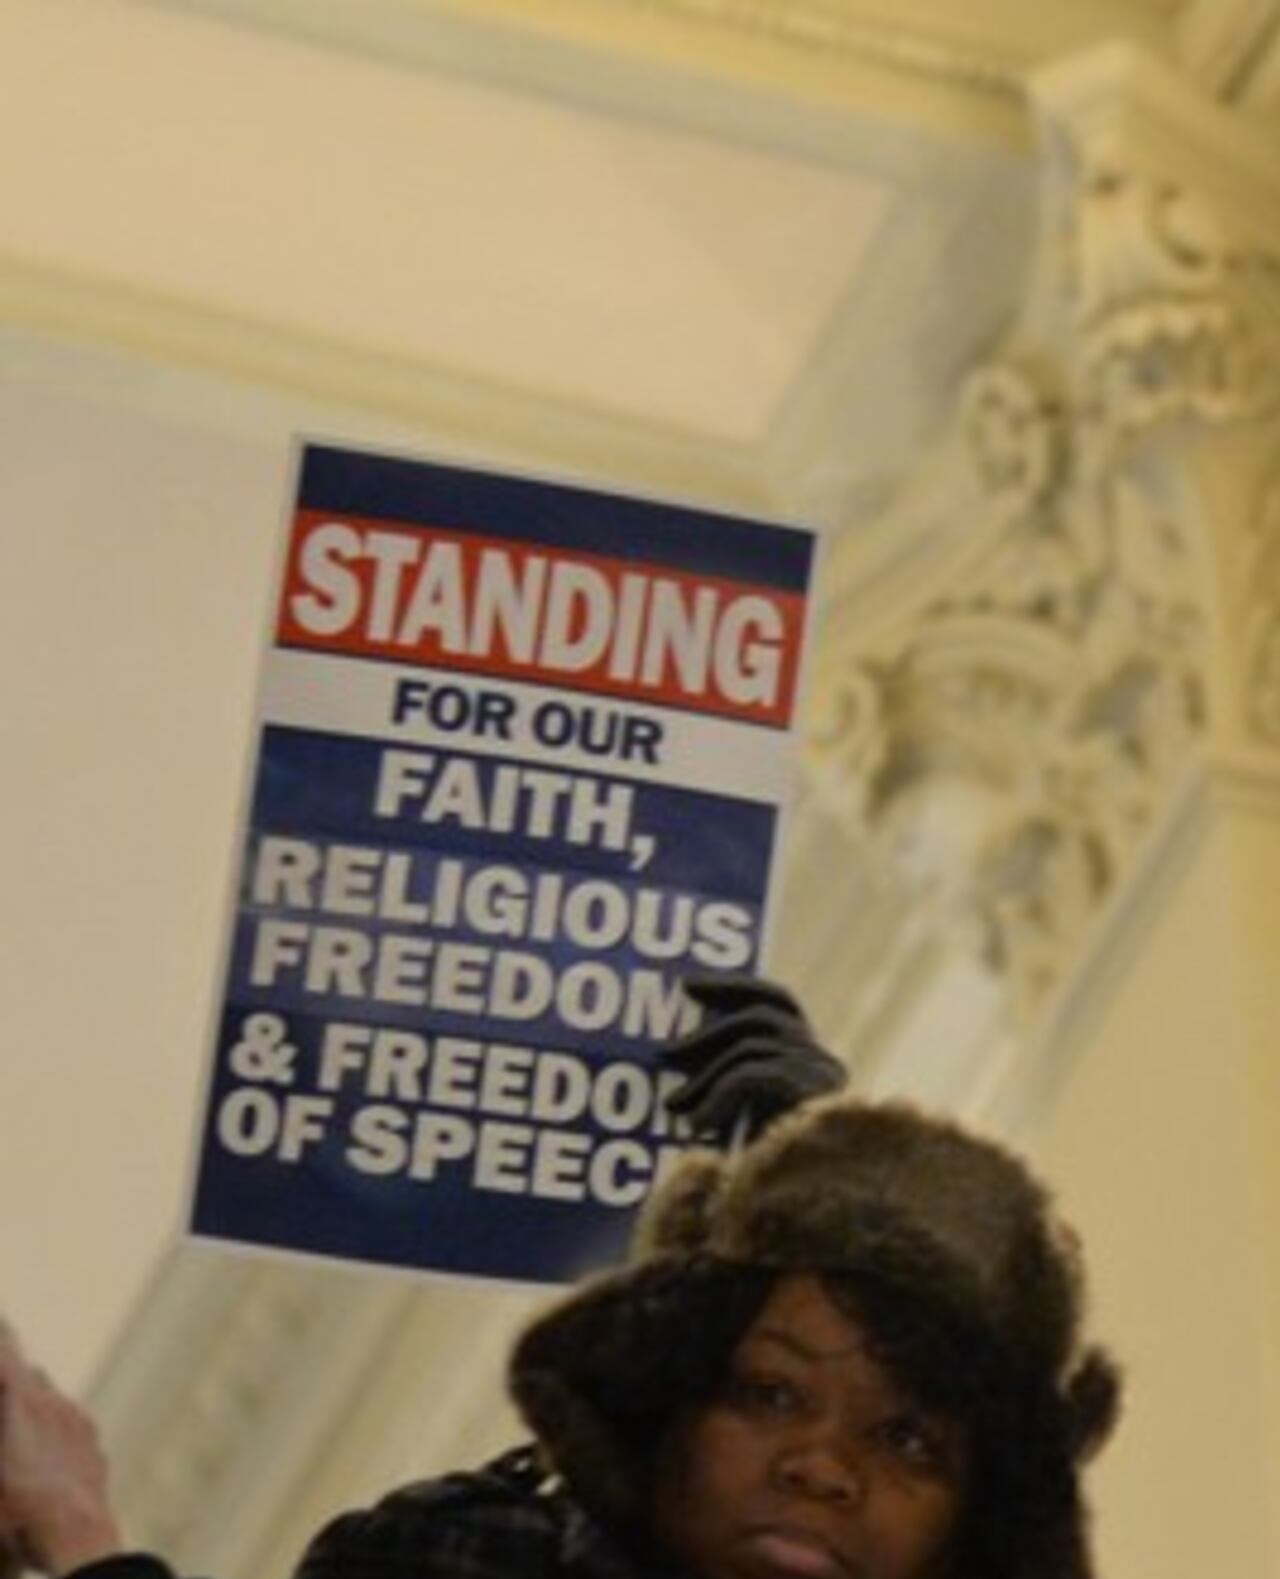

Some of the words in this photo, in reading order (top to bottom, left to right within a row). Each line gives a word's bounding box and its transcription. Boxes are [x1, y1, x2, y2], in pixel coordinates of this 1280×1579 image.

[290, 521, 792, 708] STANDING
[391, 679, 512, 741] FOR
[533, 702, 663, 764] OUR
[372, 750, 658, 866] FAITH,
[254, 836, 752, 968] RELIGIOUS
[228, 1013, 295, 1084] &
[217, 1089, 334, 1163] OF
[346, 1105, 673, 1207] SPEEC
